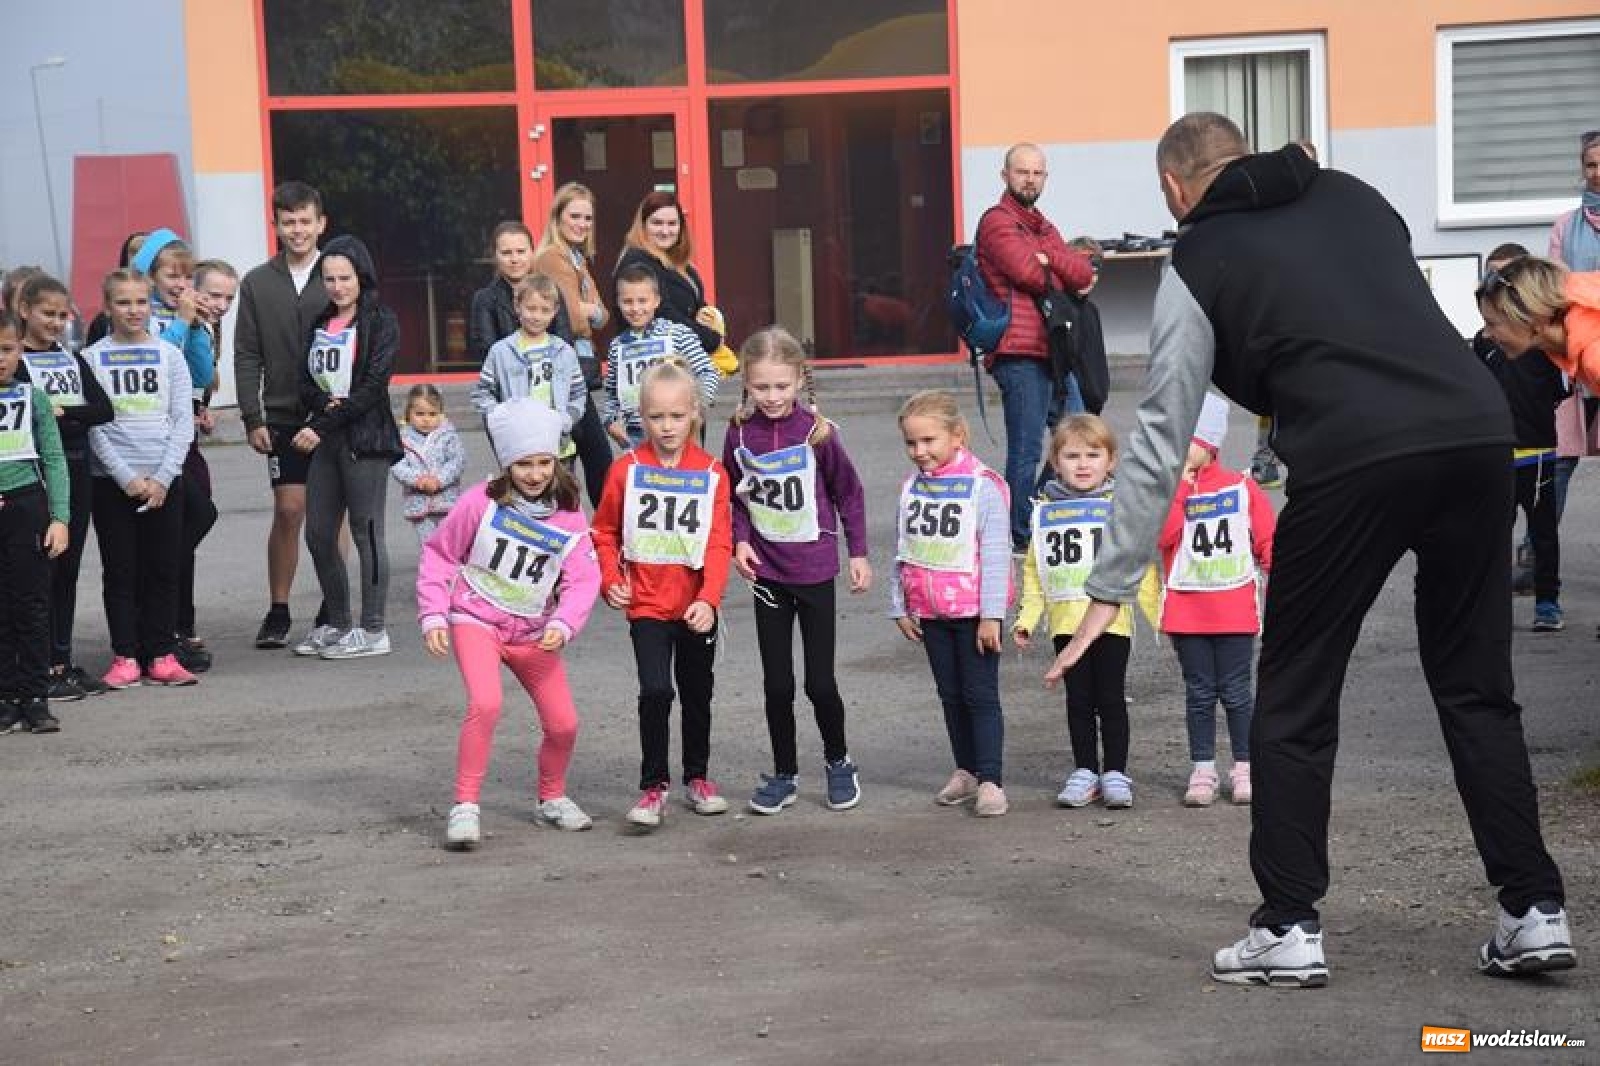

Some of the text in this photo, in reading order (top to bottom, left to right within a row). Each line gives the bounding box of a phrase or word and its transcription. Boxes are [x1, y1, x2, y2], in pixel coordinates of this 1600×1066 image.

[109, 368, 159, 395] 108
[747, 475, 805, 512] 220
[638, 494, 700, 533] 214
[906, 500, 962, 537] 256
[1046, 527, 1103, 567] 361
[1192, 518, 1233, 558] 44
[489, 537, 551, 585] 114
